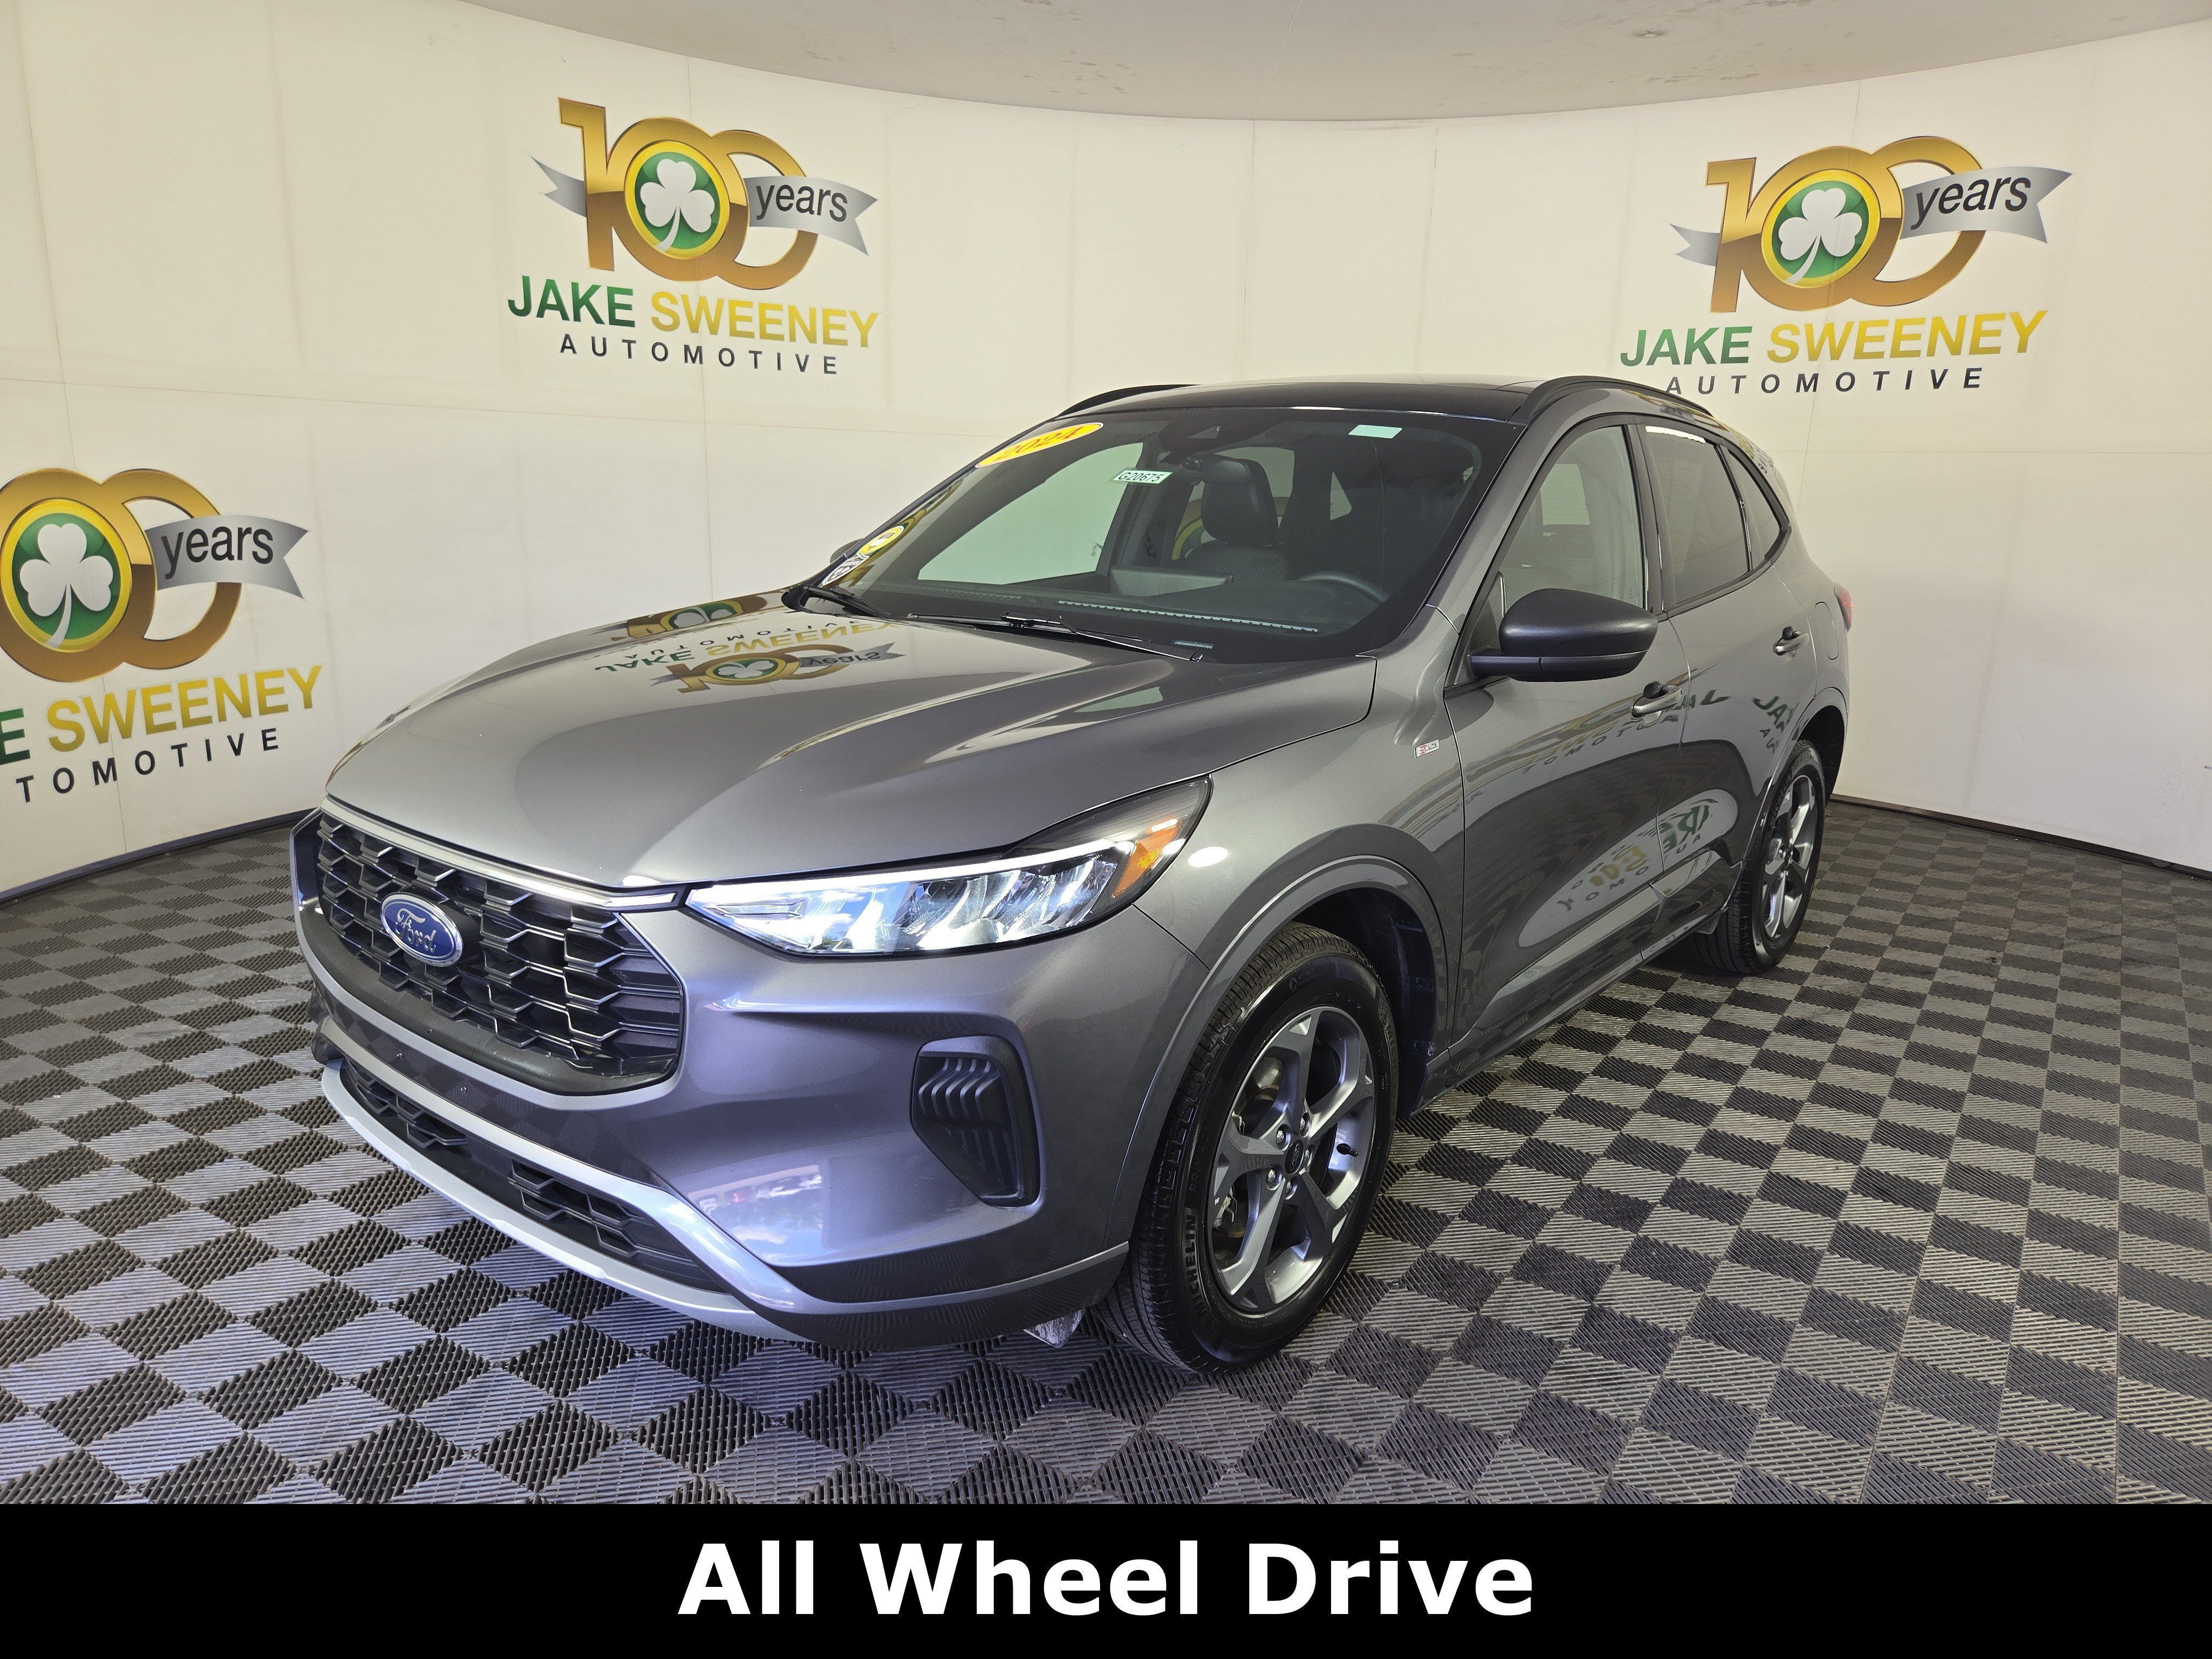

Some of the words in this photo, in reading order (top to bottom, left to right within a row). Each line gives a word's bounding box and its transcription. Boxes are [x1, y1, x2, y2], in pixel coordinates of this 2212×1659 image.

[558, 97, 819, 291] 100
[755, 183, 849, 223] years
[1706, 136, 1989, 313] 100
[1909, 176, 2032, 230] years
[507, 274, 636, 328] JAKE
[651, 291, 881, 348] SWEENEY
[1620, 326, 1753, 367] JAKE
[1767, 310, 2048, 364] SWEENEY
[560, 333, 838, 375] AUTOMOTIVE
[1666, 367, 1983, 395] AUTOMOTIVE
[995, 426, 1084, 460] 2024
[1117, 472, 1164, 483] G20675
[160, 525, 274, 580] years
[47, 664, 323, 752] SWEENEY
[395, 908, 437, 953] Ford
